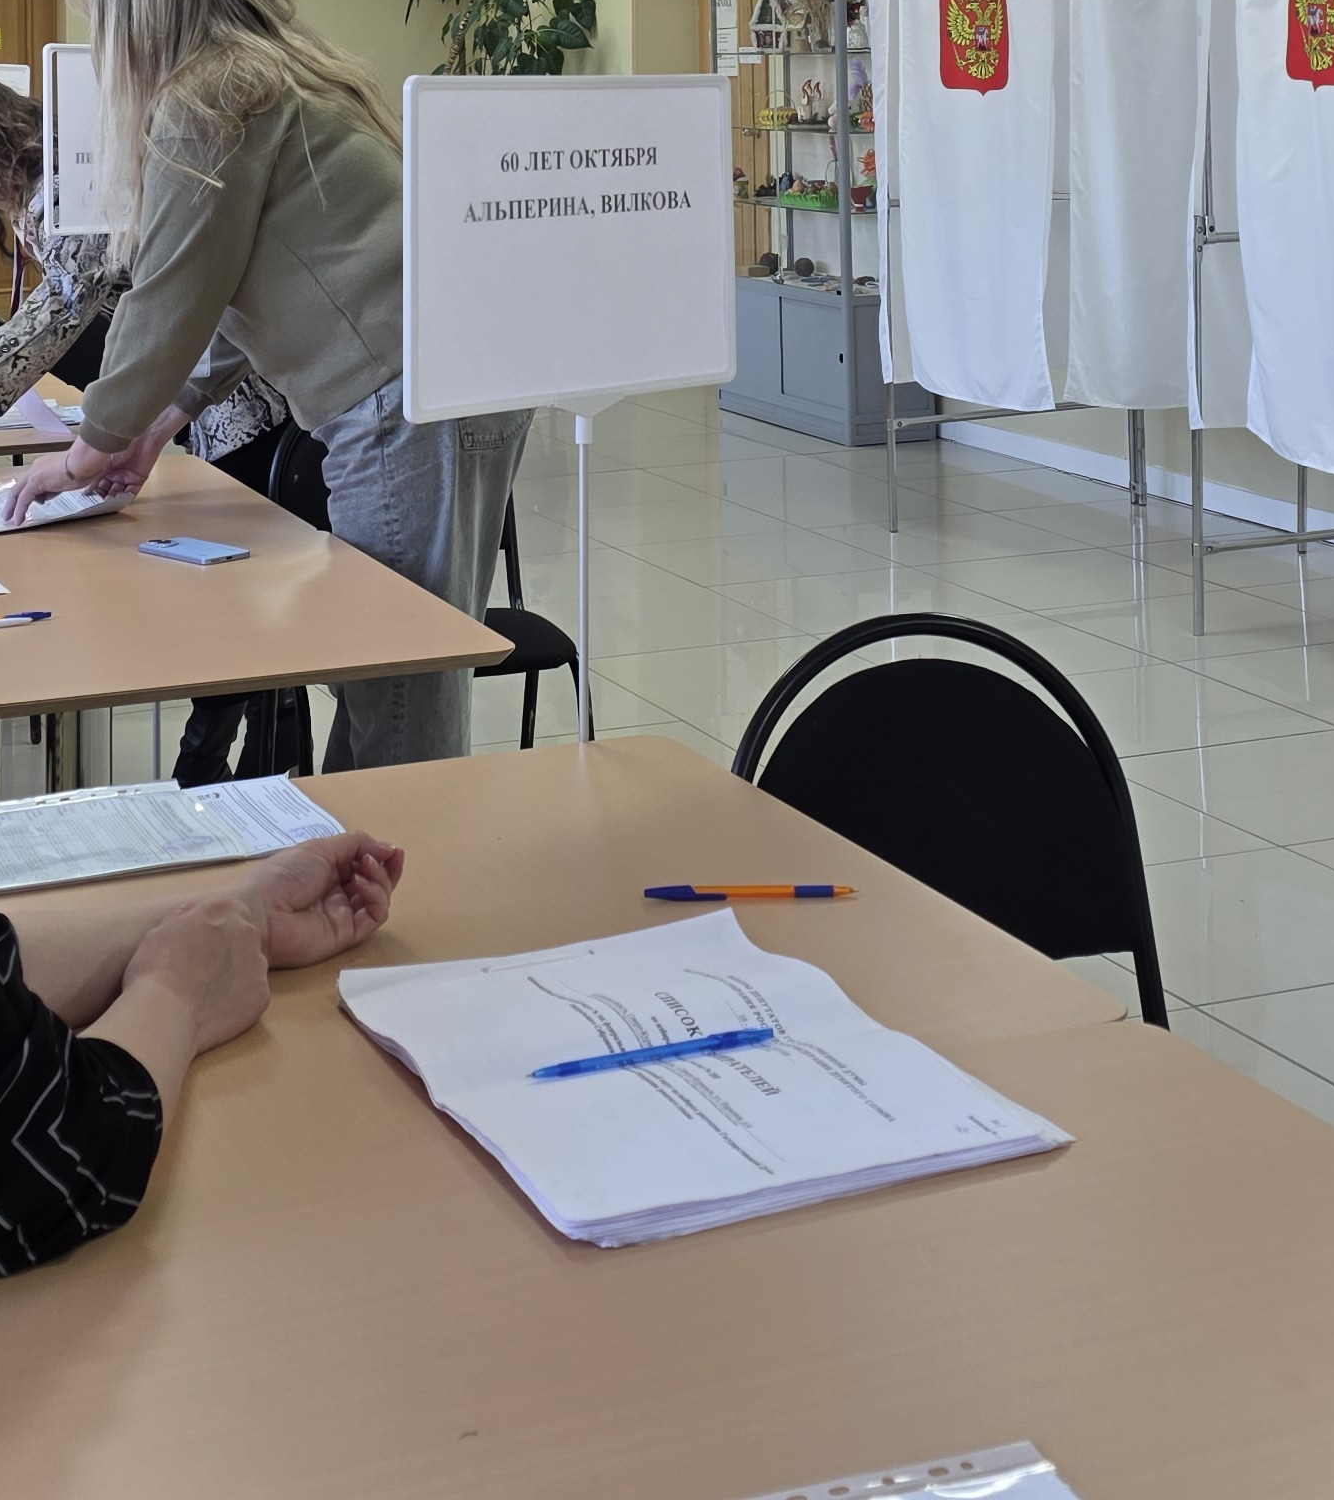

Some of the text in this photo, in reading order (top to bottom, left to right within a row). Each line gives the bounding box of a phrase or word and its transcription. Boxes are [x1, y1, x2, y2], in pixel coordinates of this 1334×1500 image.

[500, 146, 658, 173] 60 ЛЕТ ОКТЯБРЯ
[462, 190, 692, 224] АЛЬПЕРИНА, ВИЛКОВА
[653, 991, 703, 1039] СПИСОК
